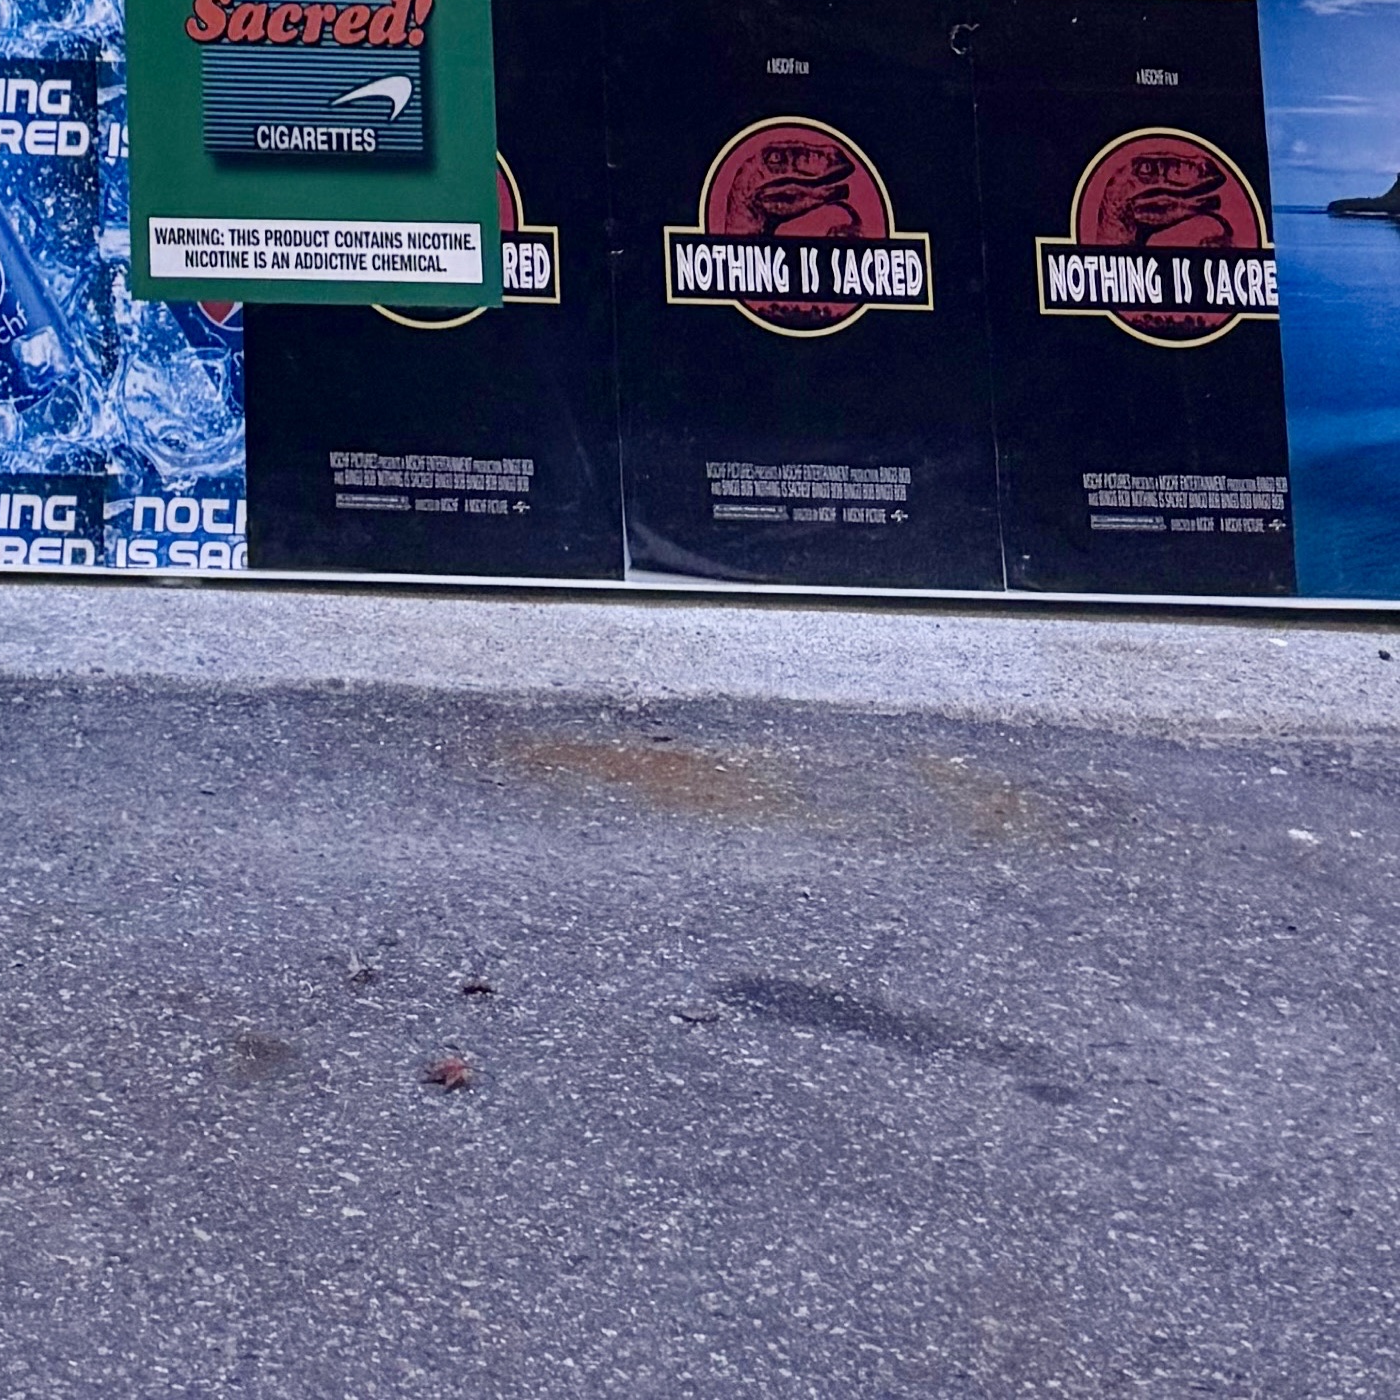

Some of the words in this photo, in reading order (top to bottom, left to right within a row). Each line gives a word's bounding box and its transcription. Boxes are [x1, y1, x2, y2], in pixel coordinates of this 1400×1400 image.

[255, 124, 377, 153] CIGARETTES
[153, 225, 225, 247] WARNING:
[227, 228, 261, 248] THIS
[263, 229, 330, 250] PRODUCT
[333, 230, 403, 251] CONTAINS
[406, 232, 477, 252] NICOTINE.
[183, 249, 250, 269] NICOTINE
[253, 250, 268, 269] IS
[270, 251, 291, 270] AN
[294, 252, 368, 271] ADDICTIVE
[371, 253, 448, 273] CHEMICAL.
[502, 241, 552, 290] RED
[675, 242, 790, 295] NOTHING
[799, 246, 820, 295] IS
[830, 247, 924, 297] SACRED
[1047, 254, 1163, 305] NOTHING
[1171, 256, 1193, 305] IS
[1204, 258, 1279, 308] SACRE
[132, 496, 246, 535] NOT
[115, 538, 158, 568] IS
